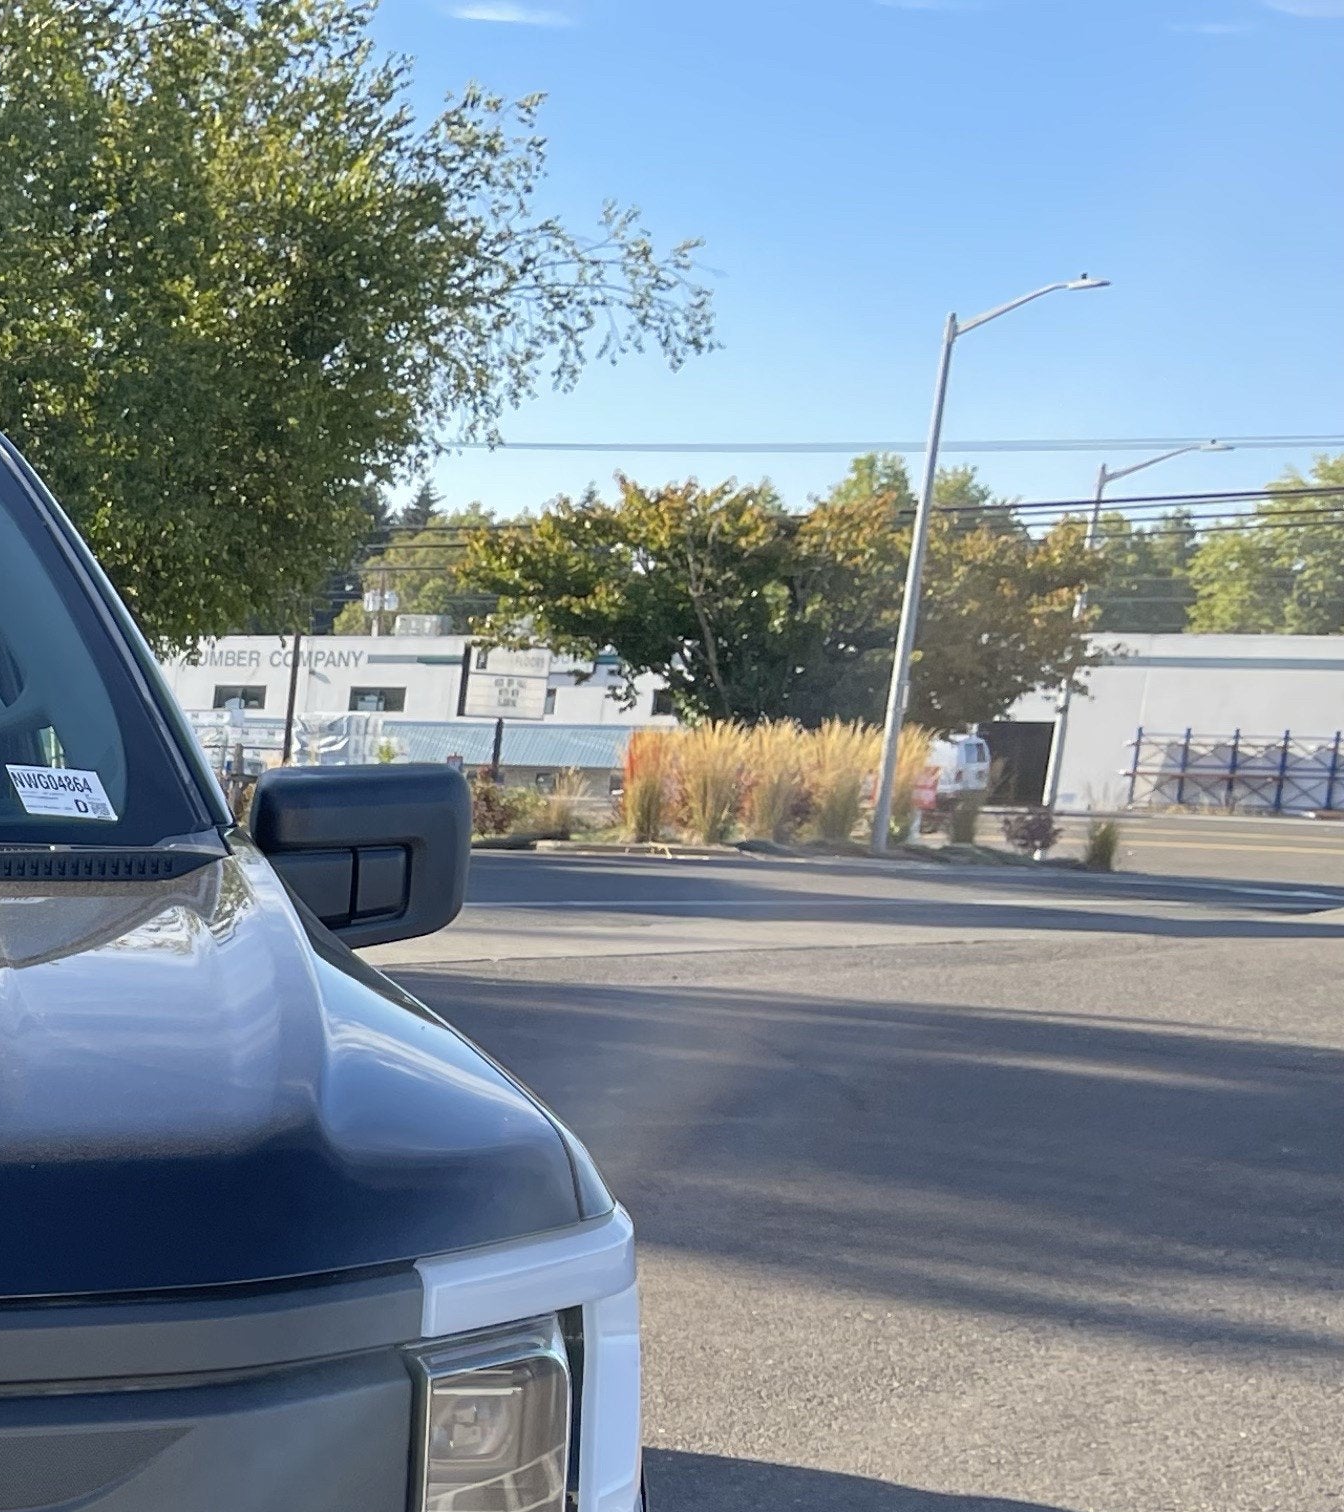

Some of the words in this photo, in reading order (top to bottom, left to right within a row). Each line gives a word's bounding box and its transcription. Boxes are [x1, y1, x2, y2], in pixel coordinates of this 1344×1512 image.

[187, 650, 261, 668] UMBER
[269, 650, 364, 668] COMPANY
[10, 772, 92, 793] NWG04864
[73, 798, 89, 814] D
